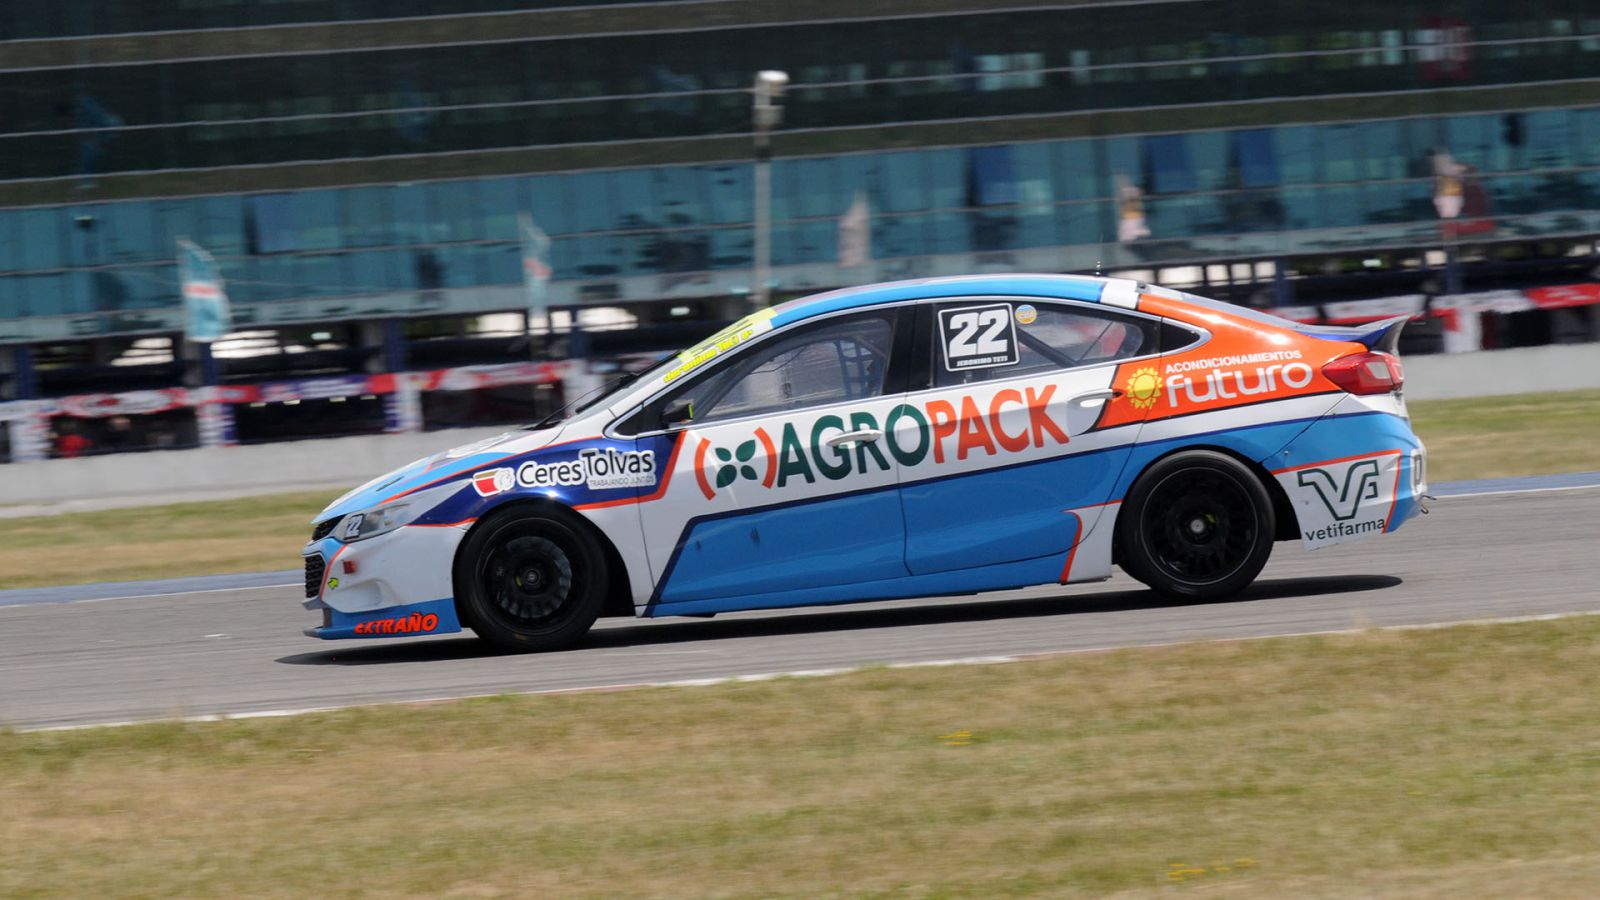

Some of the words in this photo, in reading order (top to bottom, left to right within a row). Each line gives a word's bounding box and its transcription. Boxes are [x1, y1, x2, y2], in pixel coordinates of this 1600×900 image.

[949, 309, 1009, 358] 22
[1164, 362, 1314, 408] futuro
[1165, 351, 1303, 374] ACONDICIONAMIENTOS
[777, 384, 1070, 488] AGROPACK
[1304, 518, 1386, 541] vetifarma
